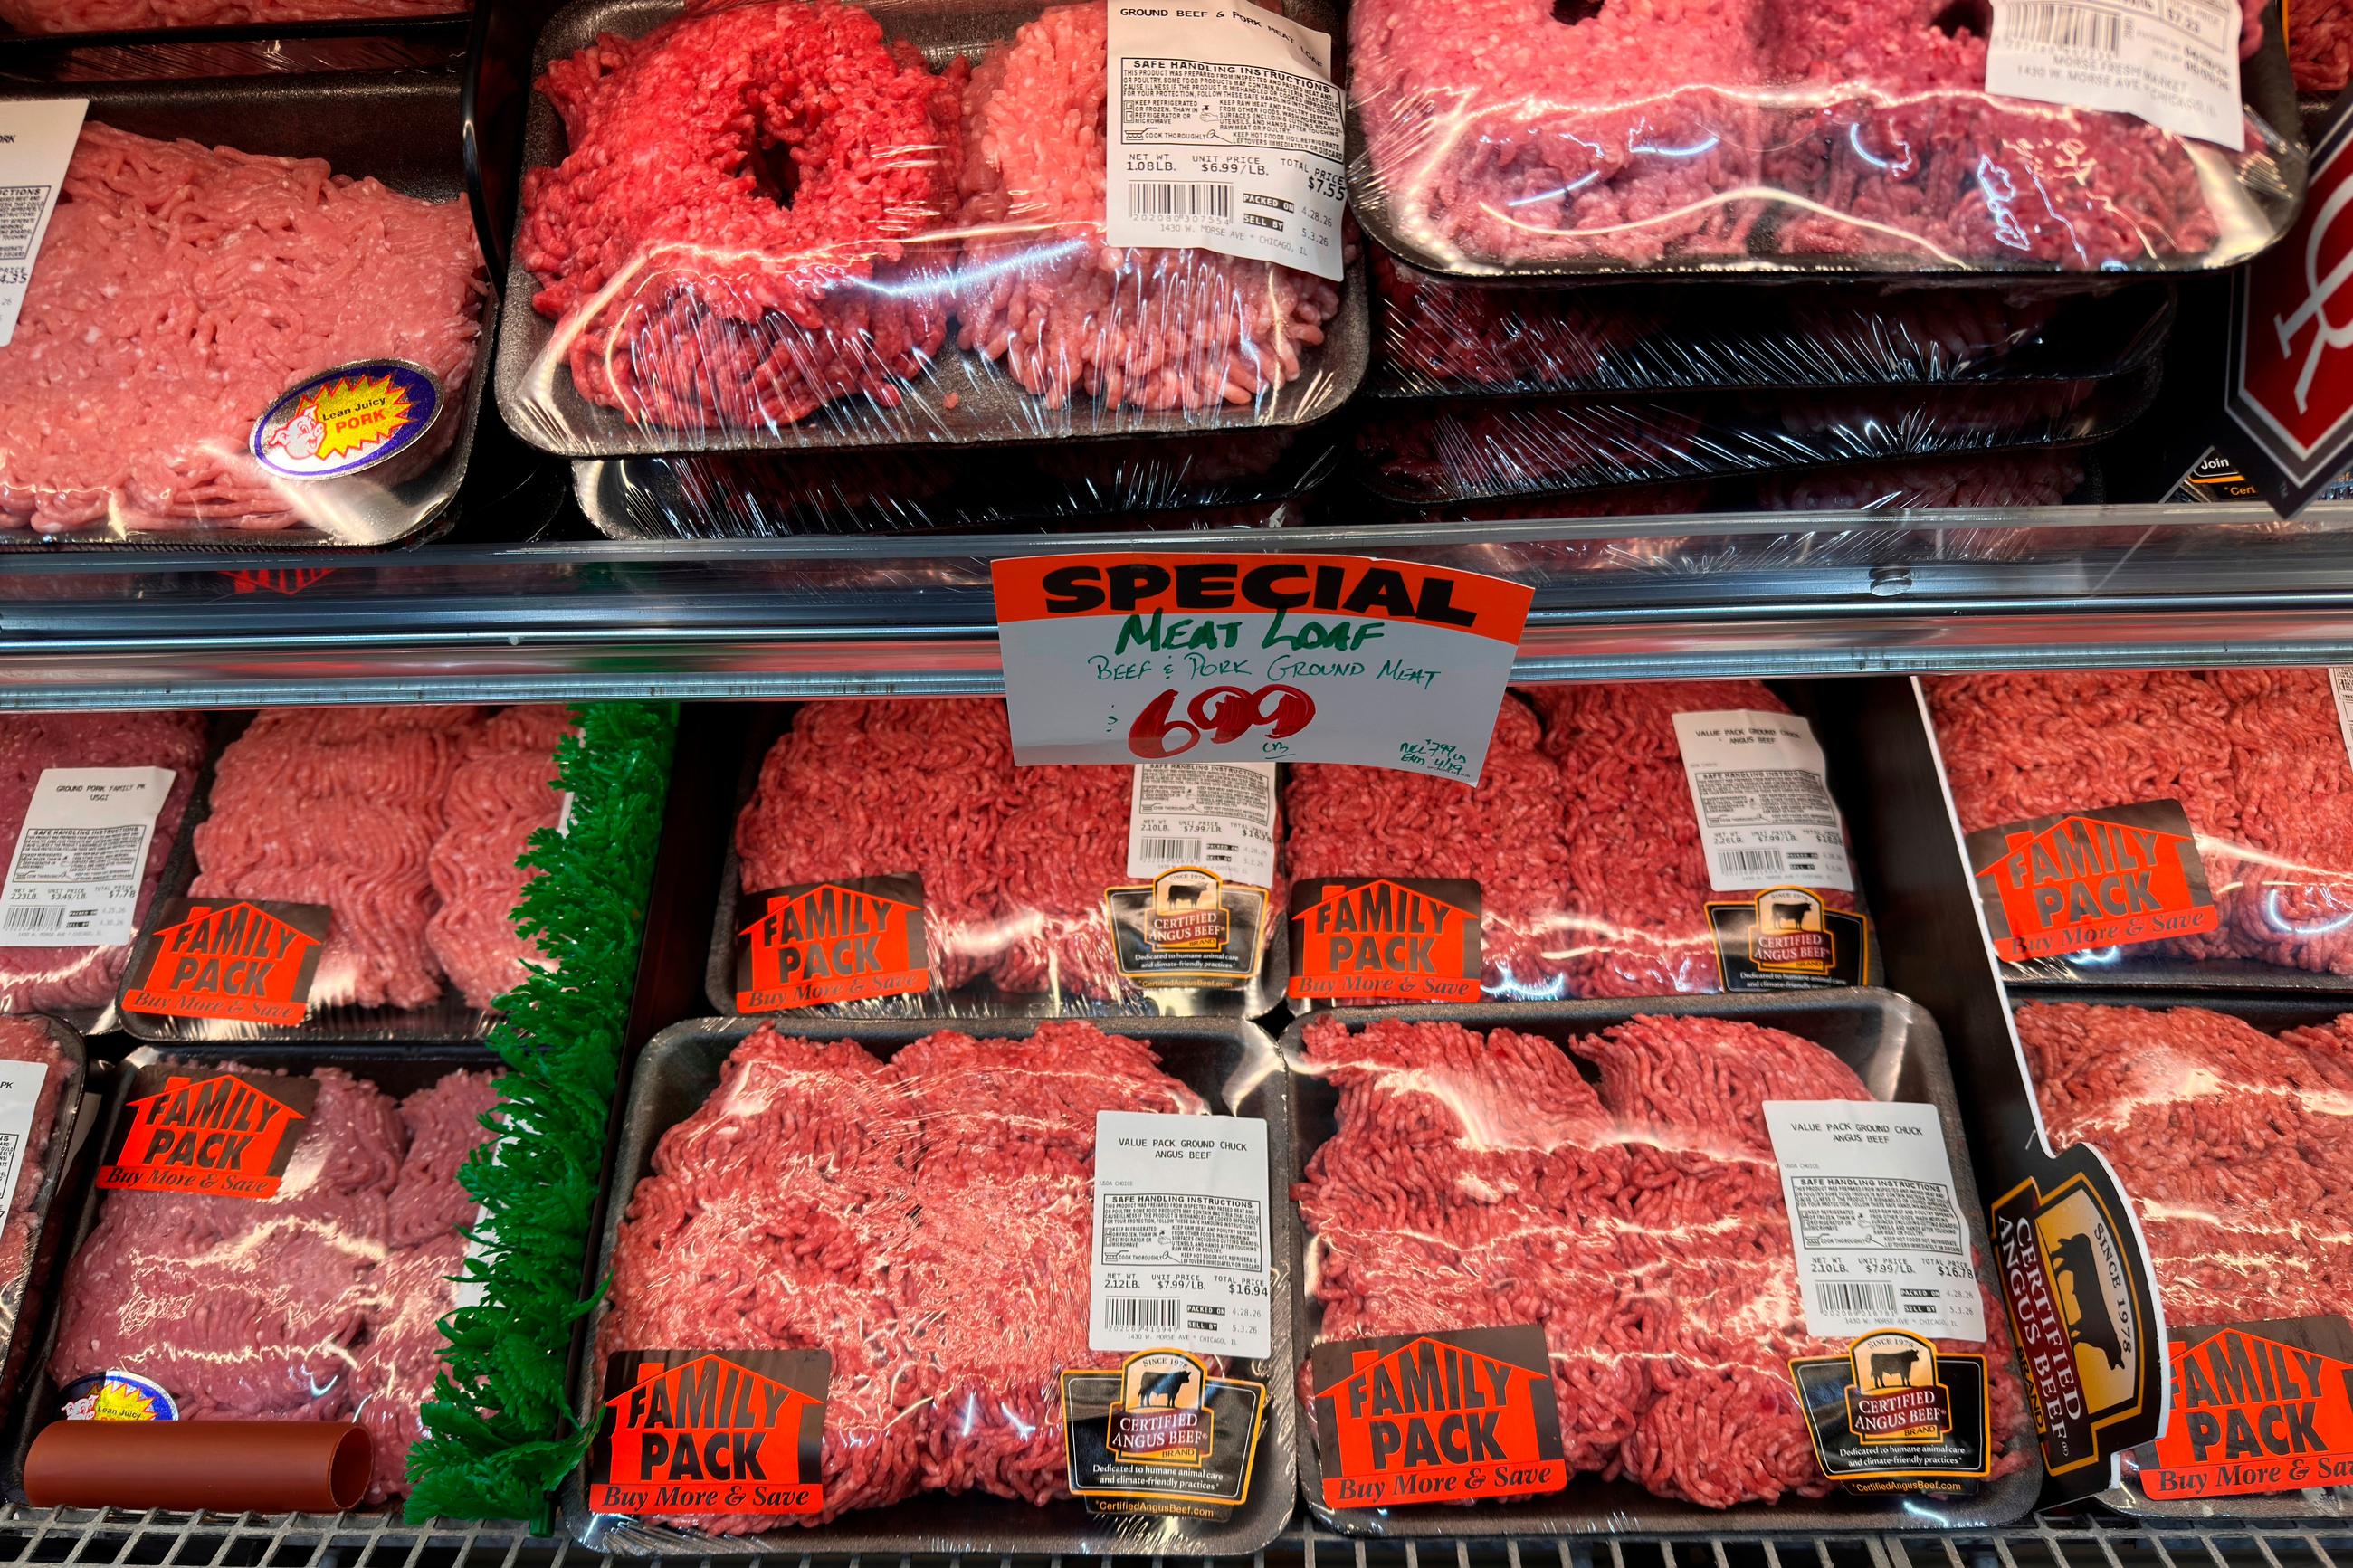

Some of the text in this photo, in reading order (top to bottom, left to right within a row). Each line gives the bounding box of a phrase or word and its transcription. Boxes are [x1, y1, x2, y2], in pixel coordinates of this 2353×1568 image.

[1120, 8, 1168, 17] GROUND
[1176, 10, 1208, 18] BEEF
[1233, 11, 1262, 27] PORK
[1268, 26, 1294, 43] MEAT
[1300, 46, 1323, 68] LOAF
[1133, 60, 1329, 93] SAFE HANDLING INSTRUCTIONS
[1281, 158, 1309, 173] TOTAL
[1314, 168, 1345, 185] PRICE
[1307, 176, 1345, 201] $7.55
[1243, 195, 1332, 227] PACKED ON 4.28.26
[1243, 214, 1329, 246] SELL BY 5.3.26
[322, 396, 386, 421] Lean Juicy
[336, 410, 386, 434] PORK
[2201, 458, 2230, 470] Join
[1042, 563, 1478, 628] SPECIAL
[1114, 607, 1386, 656] MEAT LOAF
[1087, 656, 1153, 681] BEEF
[1183, 653, 1253, 678] PORK
[1266, 660, 1366, 683] GROUND
[1376, 661, 1443, 690] MEAT
[2007, 821, 2158, 889] FAMILY
[1317, 885, 1451, 935] FAMILY
[2034, 871, 2163, 927] PACK
[765, 888, 893, 946] FAMILY
[1154, 913, 1216, 929] CERTIFIED
[172, 905, 297, 960] FAMILY
[1149, 928, 1191, 942] ANGUS
[1758, 935, 1823, 948] CERTIFIED
[778, 936, 883, 984] PACK
[1329, 936, 1437, 973] PACK
[1755, 947, 1798, 960] ANGUS
[171, 958, 276, 997] PACK
[1299, 976, 1470, 995] Buy More & Save
[133, 993, 293, 1018] Buy More & Save
[146, 1079, 281, 1134] FAMILY
[1826, 1123, 1851, 1131] PACK
[1855, 1124, 1890, 1132] GROUND
[1894, 1126, 1923, 1136] CHUCK
[1833, 1135, 1890, 1144] ANGUS BEEF
[143, 1129, 254, 1171] PACK
[1119, 1138, 1247, 1151] VALUE PACK GROUND CHUCK
[1155, 1151, 1212, 1160] ANGUS BEEF
[107, 1167, 268, 1193] Buy More & Save
[1187, 1197, 1253, 1209] INSTRUCTIONS
[1229, 1285, 1268, 1297] $16.94
[1998, 1215, 2041, 1345] ANGUS
[2094, 1223, 2132, 1354] SINCE 1978
[1187, 1306, 1213, 1314] PACKED
[1232, 1308, 1262, 1317] 4.28.26
[2016, 1217, 2082, 1421] CERTIFIED
[1188, 1321, 1205, 1329] SELL
[1232, 1325, 1258, 1334] 5.3.26
[1868, 1339, 1914, 1349] SINCE 1978
[1143, 1358, 1187, 1369] SINCE 1978
[1348, 1342, 1513, 1419] FAMILY
[2015, 1346, 2043, 1430] BRAND
[628, 1360, 790, 1429] FAMILY
[1859, 1391, 1934, 1413] CERTIFIED
[97, 1406, 141, 1420] Lean Juicy
[1120, 1413, 1197, 1431] CERTIFIED
[1855, 1412, 1906, 1430] ANGUS
[1112, 1431, 1165, 1448] ANGUS
[1369, 1411, 1508, 1470] PACK
[1904, 1426, 1936, 1436] BRAND
[2185, 1402, 2329, 1462] PACK
[641, 1433, 767, 1480] PACK
[1162, 1449, 1195, 1458] BRAND
[1840, 1448, 1879, 1457] Dedicated
[1890, 1446, 1920, 1454] humane
[1921, 1445, 1948, 1453] animal
[1849, 1458, 1862, 1467] and
[1863, 1456, 1922, 1468] climate-friendly
[1093, 1464, 1223, 1480] Dedicated to humane animal care
[1100, 1476, 1114, 1484] and
[1116, 1476, 1178, 1487] climate-friendly
[1338, 1467, 1552, 1502] Buy More & Save
[2158, 1470, 2207, 1494] Buy
[2216, 1466, 2281, 1487] More
[2289, 1459, 2310, 1478] &
[602, 1486, 810, 1512] Buy More & Save
